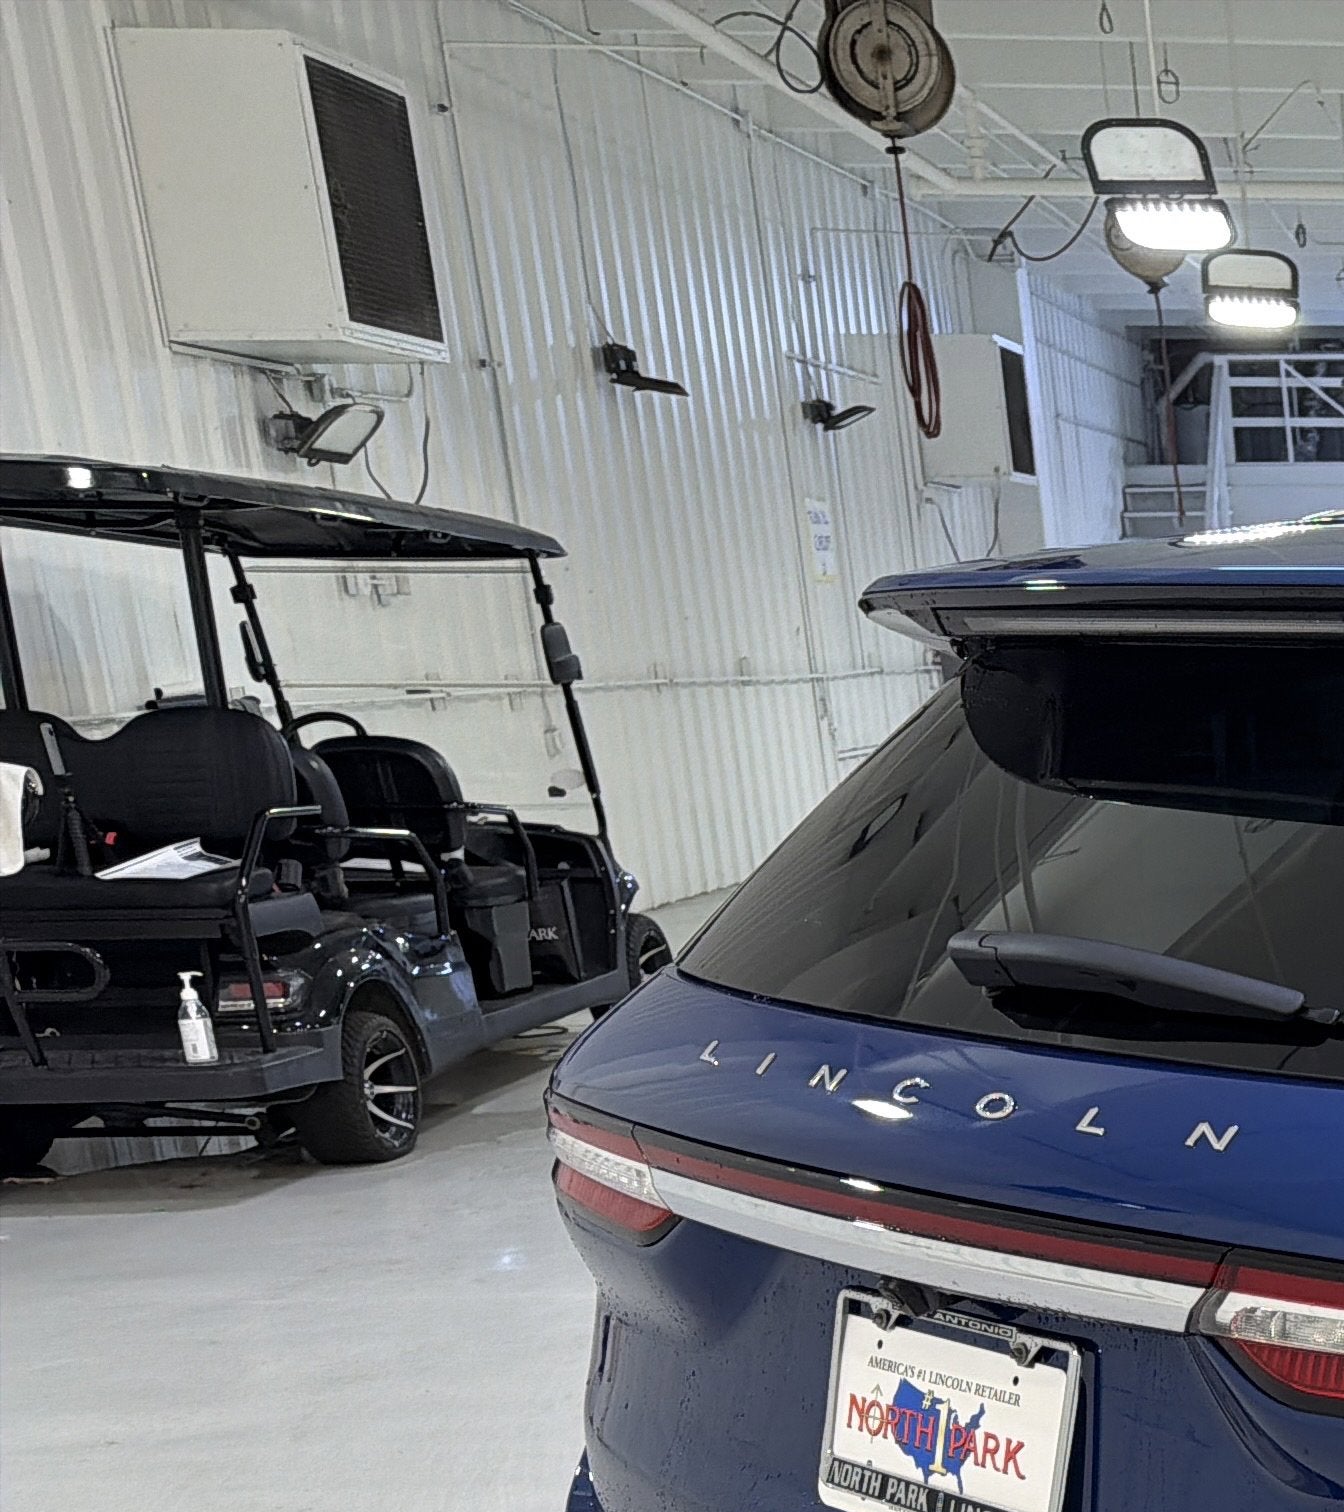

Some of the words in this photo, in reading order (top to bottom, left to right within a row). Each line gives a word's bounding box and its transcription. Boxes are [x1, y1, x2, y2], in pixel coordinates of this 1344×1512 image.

[528, 926, 559, 941] ARK
[699, 1039, 1240, 1152] LINCOLN
[933, 1311, 1012, 1338] ANTONIO
[868, 1355, 916, 1379] AMERICA'S
[928, 1370, 974, 1393] LINCOLN
[974, 1386, 1021, 1407] RETAILER
[847, 1393, 936, 1452] NORTH
[948, 1424, 1027, 1480] PARK
[829, 1460, 884, 1497] NORTH
